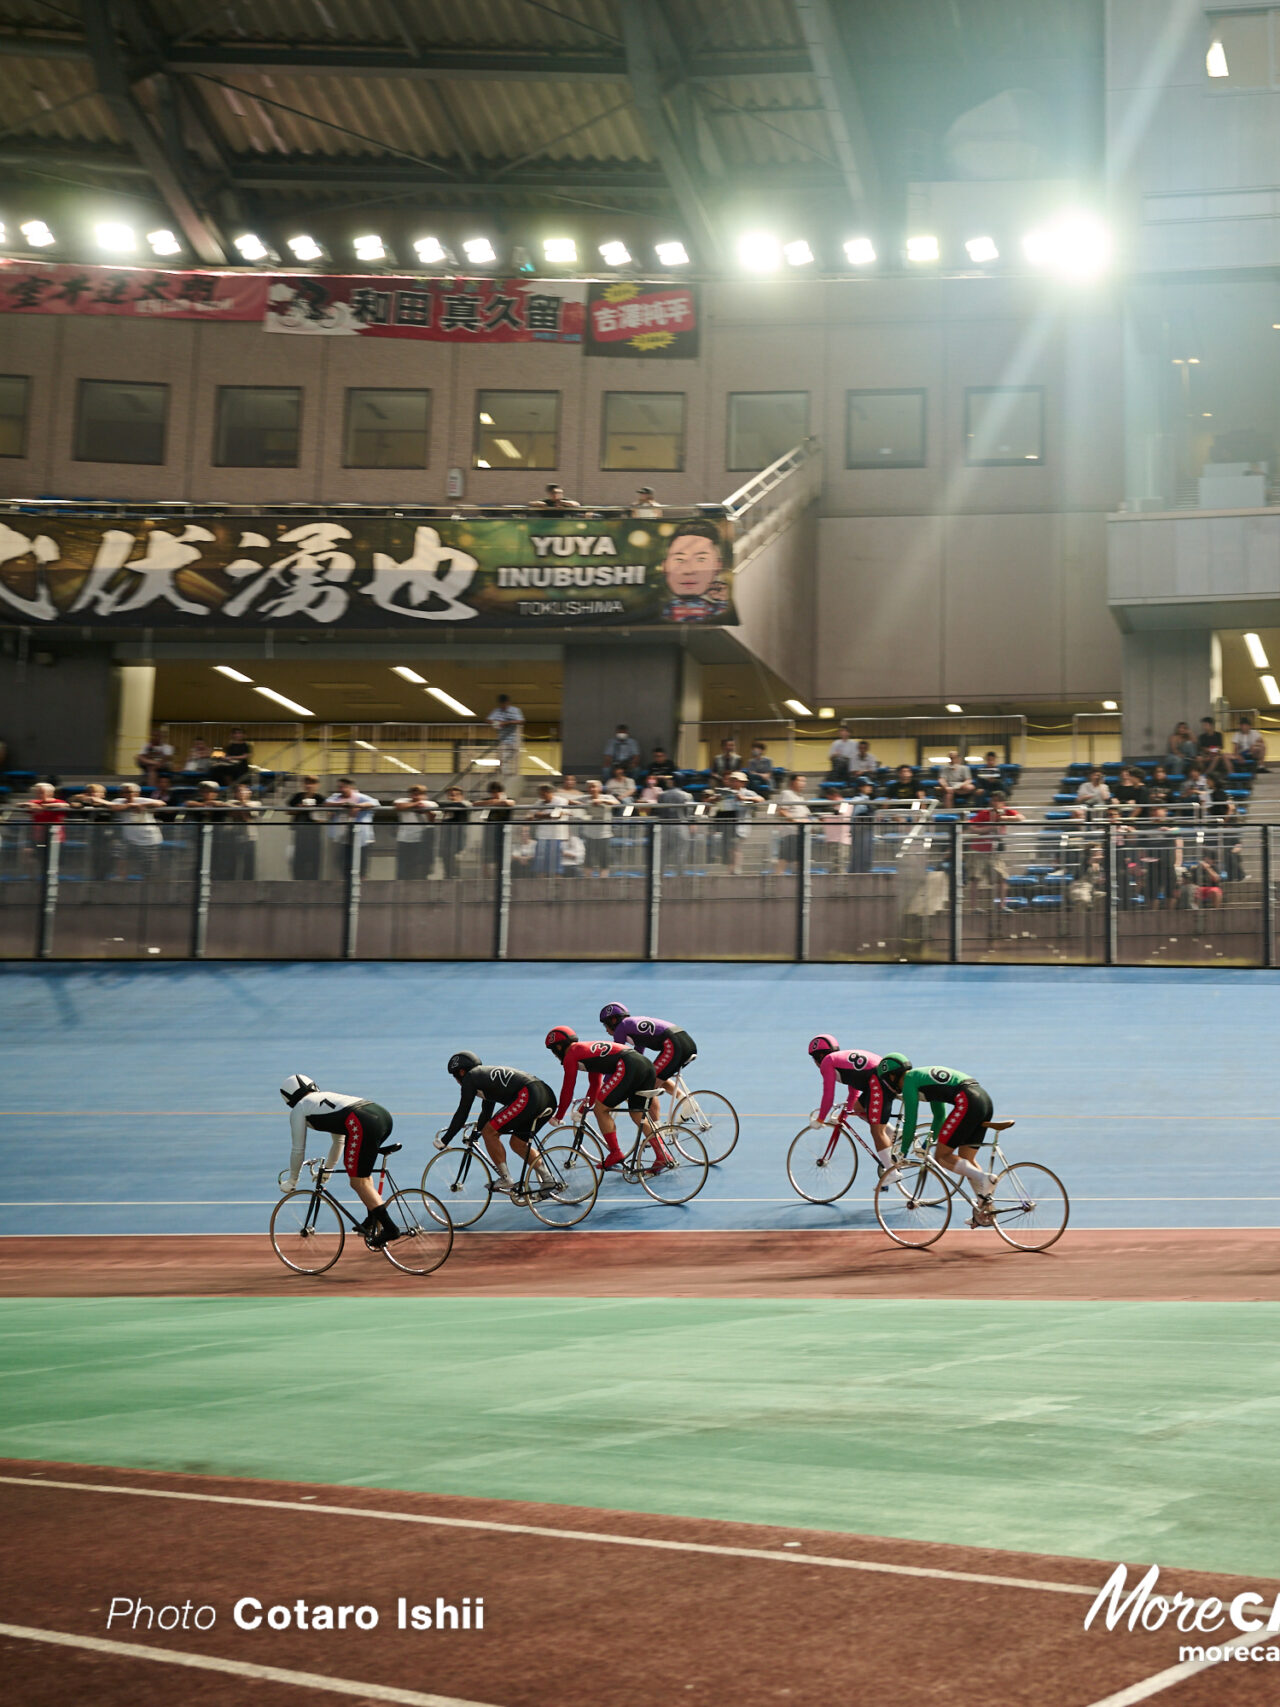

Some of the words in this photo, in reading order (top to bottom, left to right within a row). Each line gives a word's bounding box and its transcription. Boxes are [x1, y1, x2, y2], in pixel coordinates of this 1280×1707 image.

[351, 287, 562, 332] 和田真久留
[530, 536, 617, 556] YUYA
[497, 565, 646, 587] INUBUSHI
[517, 601, 624, 616] TOKUSHIMA
[637, 1020, 655, 1036] 9
[590, 1041, 612, 1057] 3
[848, 1052, 867, 1071] 8
[881, 1060, 889, 1072] 6
[490, 1066, 514, 1087] 2
[929, 1066, 951, 1084] 6
